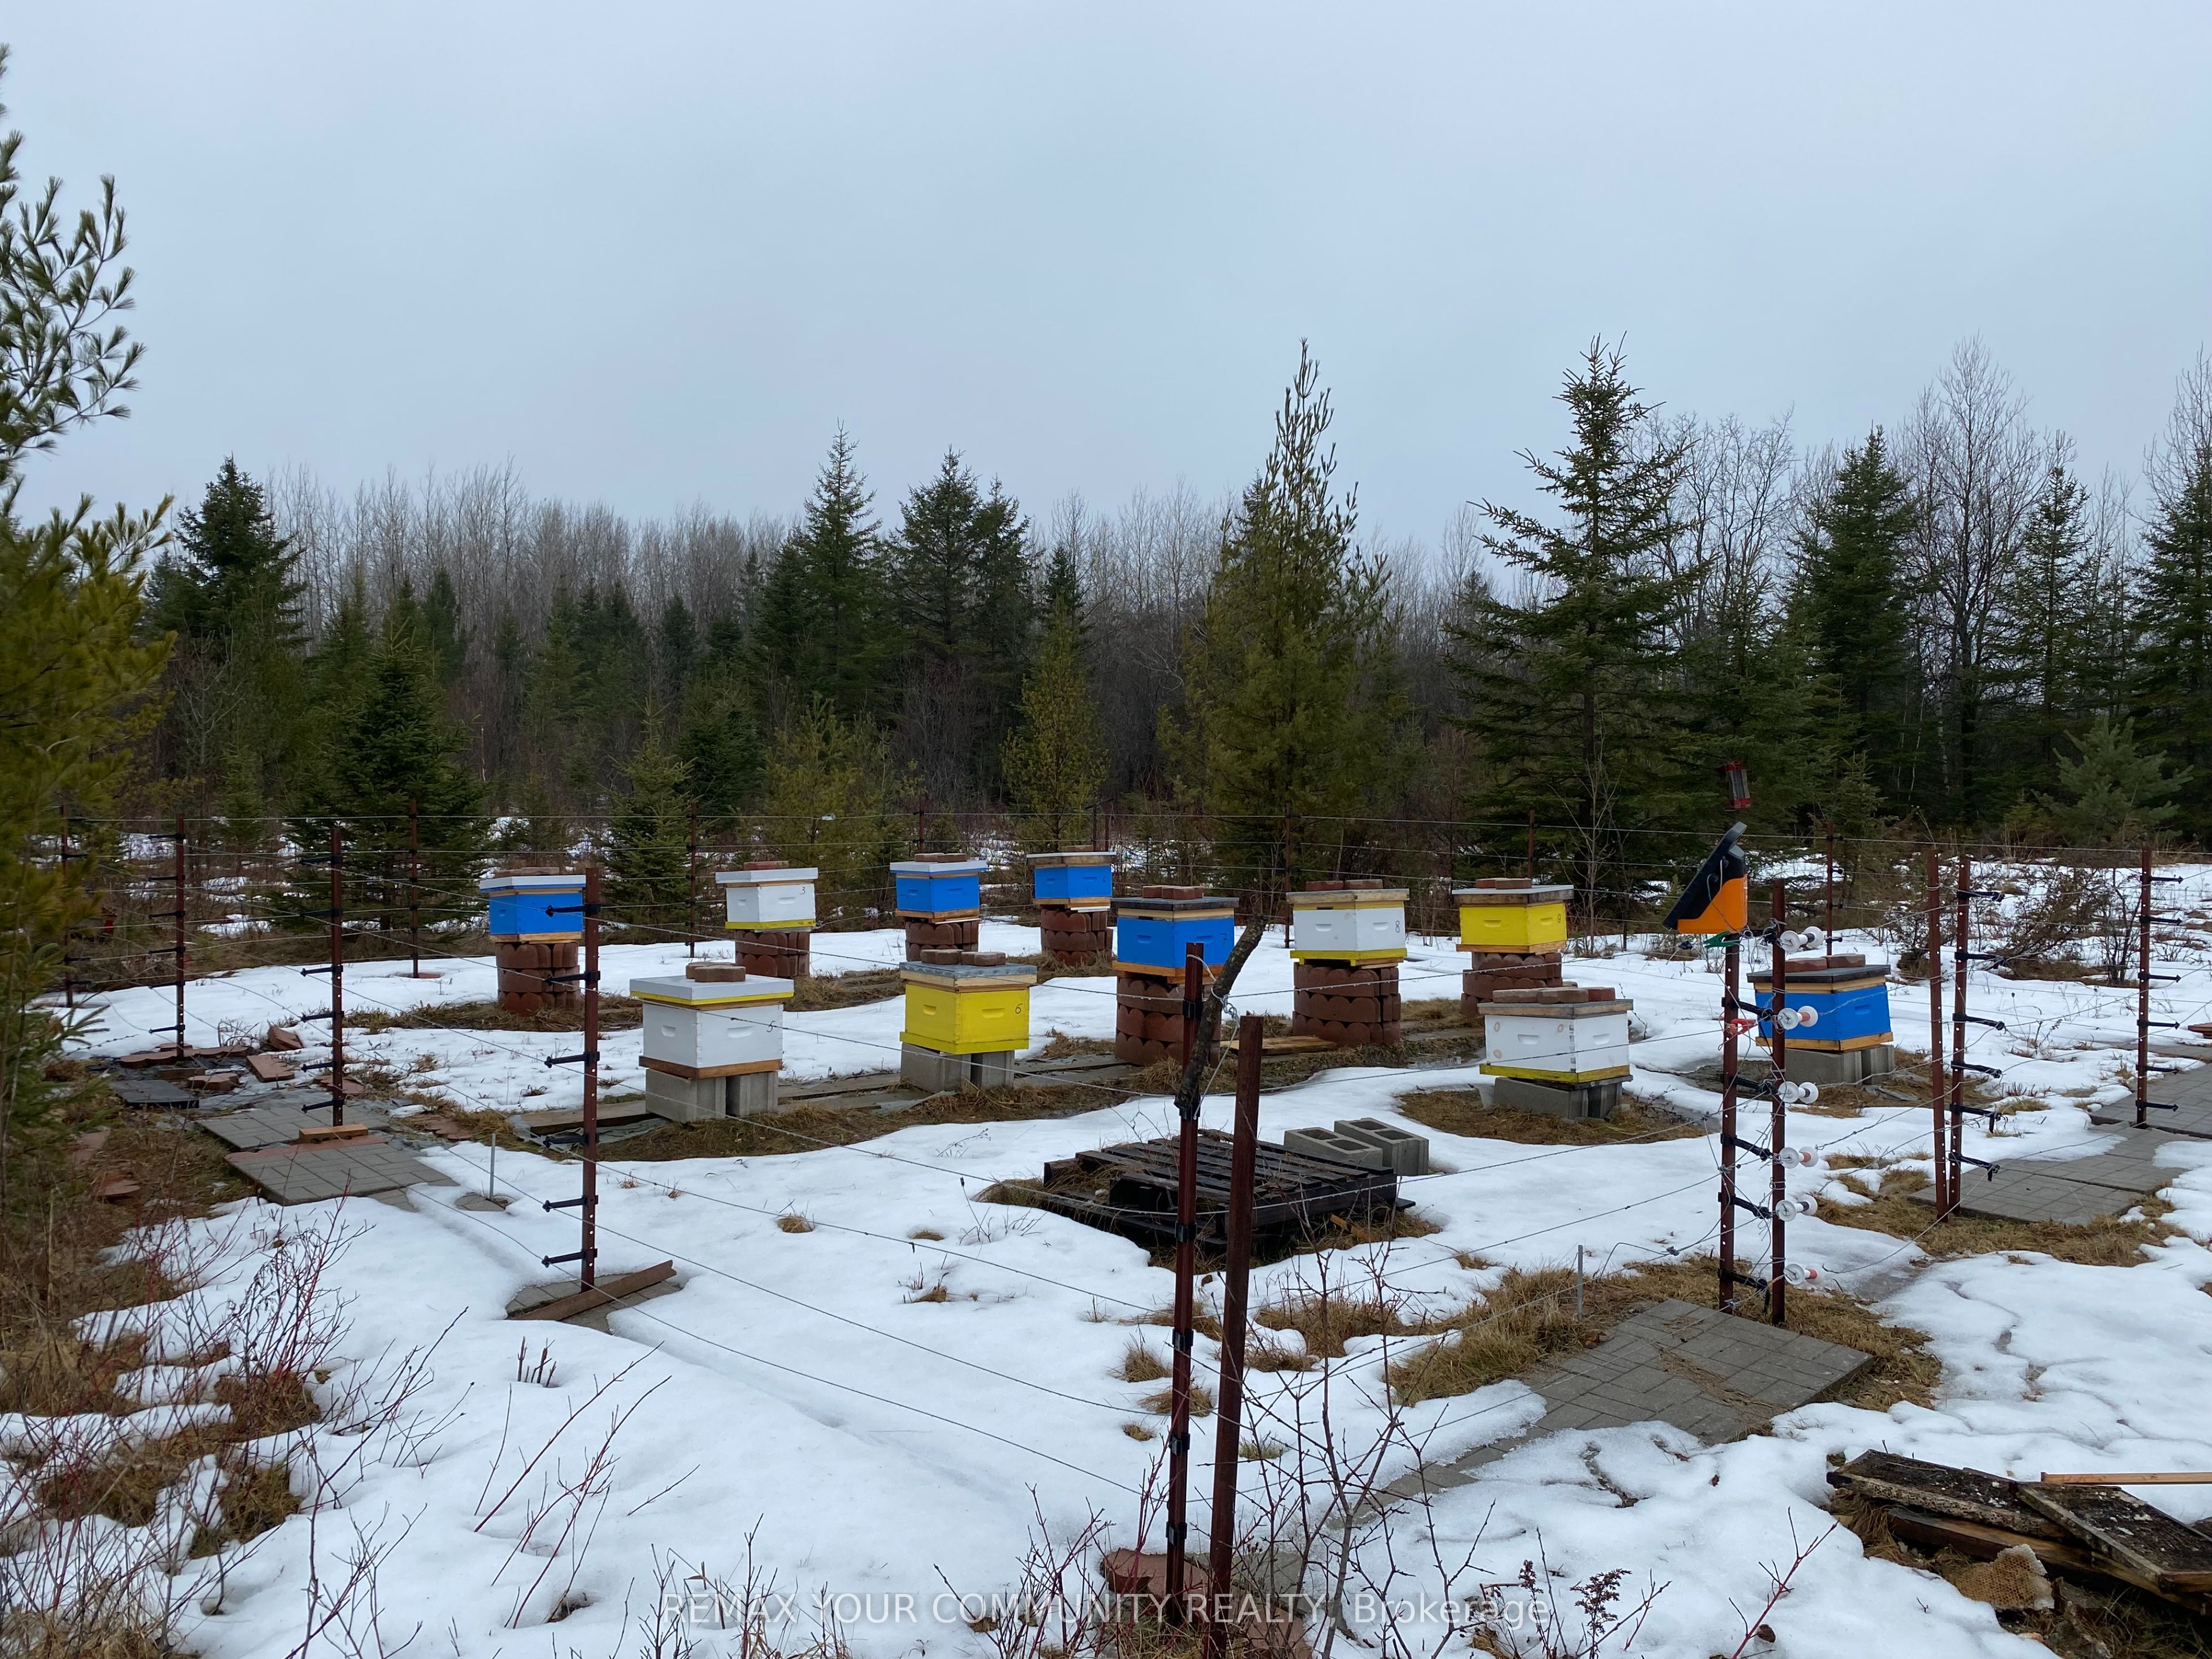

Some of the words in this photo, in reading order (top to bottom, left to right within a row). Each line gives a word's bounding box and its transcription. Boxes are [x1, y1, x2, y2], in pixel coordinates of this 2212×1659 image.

[799, 886, 806, 895] 3
[1395, 920, 1400, 933] 8
[1219, 933, 1229, 945] 7
[1015, 1003, 1023, 1014] 6
